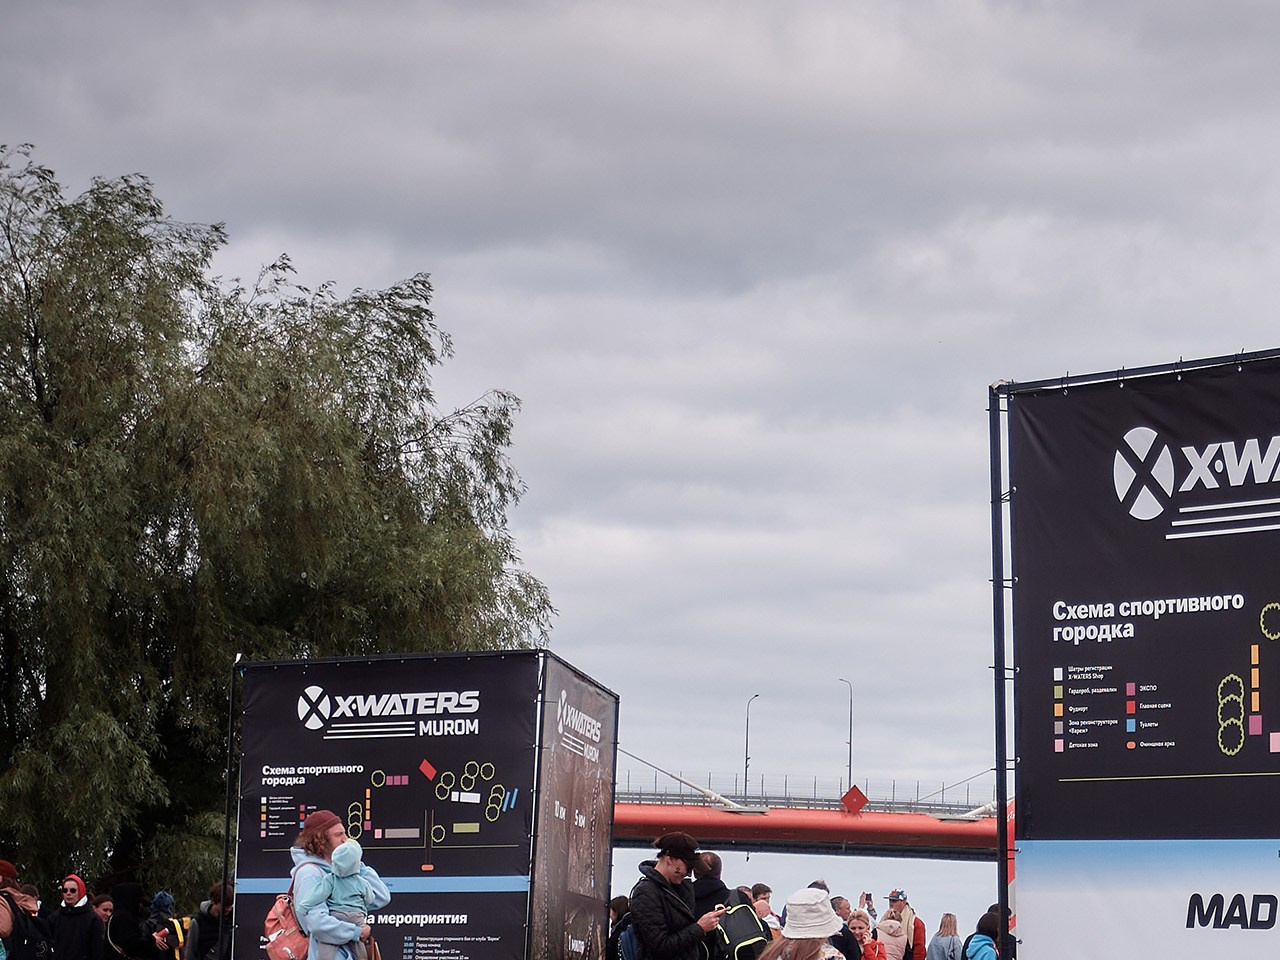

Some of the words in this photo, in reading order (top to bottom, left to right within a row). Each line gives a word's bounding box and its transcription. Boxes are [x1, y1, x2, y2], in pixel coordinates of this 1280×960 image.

[1052, 600, 1115, 621] Схема
[1118, 593, 1245, 620] спортивного
[1052, 622, 1135, 646] городка
[419, 718, 479, 736] MUROM
[583, 743, 599, 763] MUROM
[262, 765, 295, 776] Схема
[296, 764, 364, 777] спортивного
[261, 775, 306, 788] городка
[554, 800, 560, 818] 10
[574, 809, 579, 826] 5
[377, 913, 468, 928] мероприятия
[1186, 892, 1277, 931] MAD
